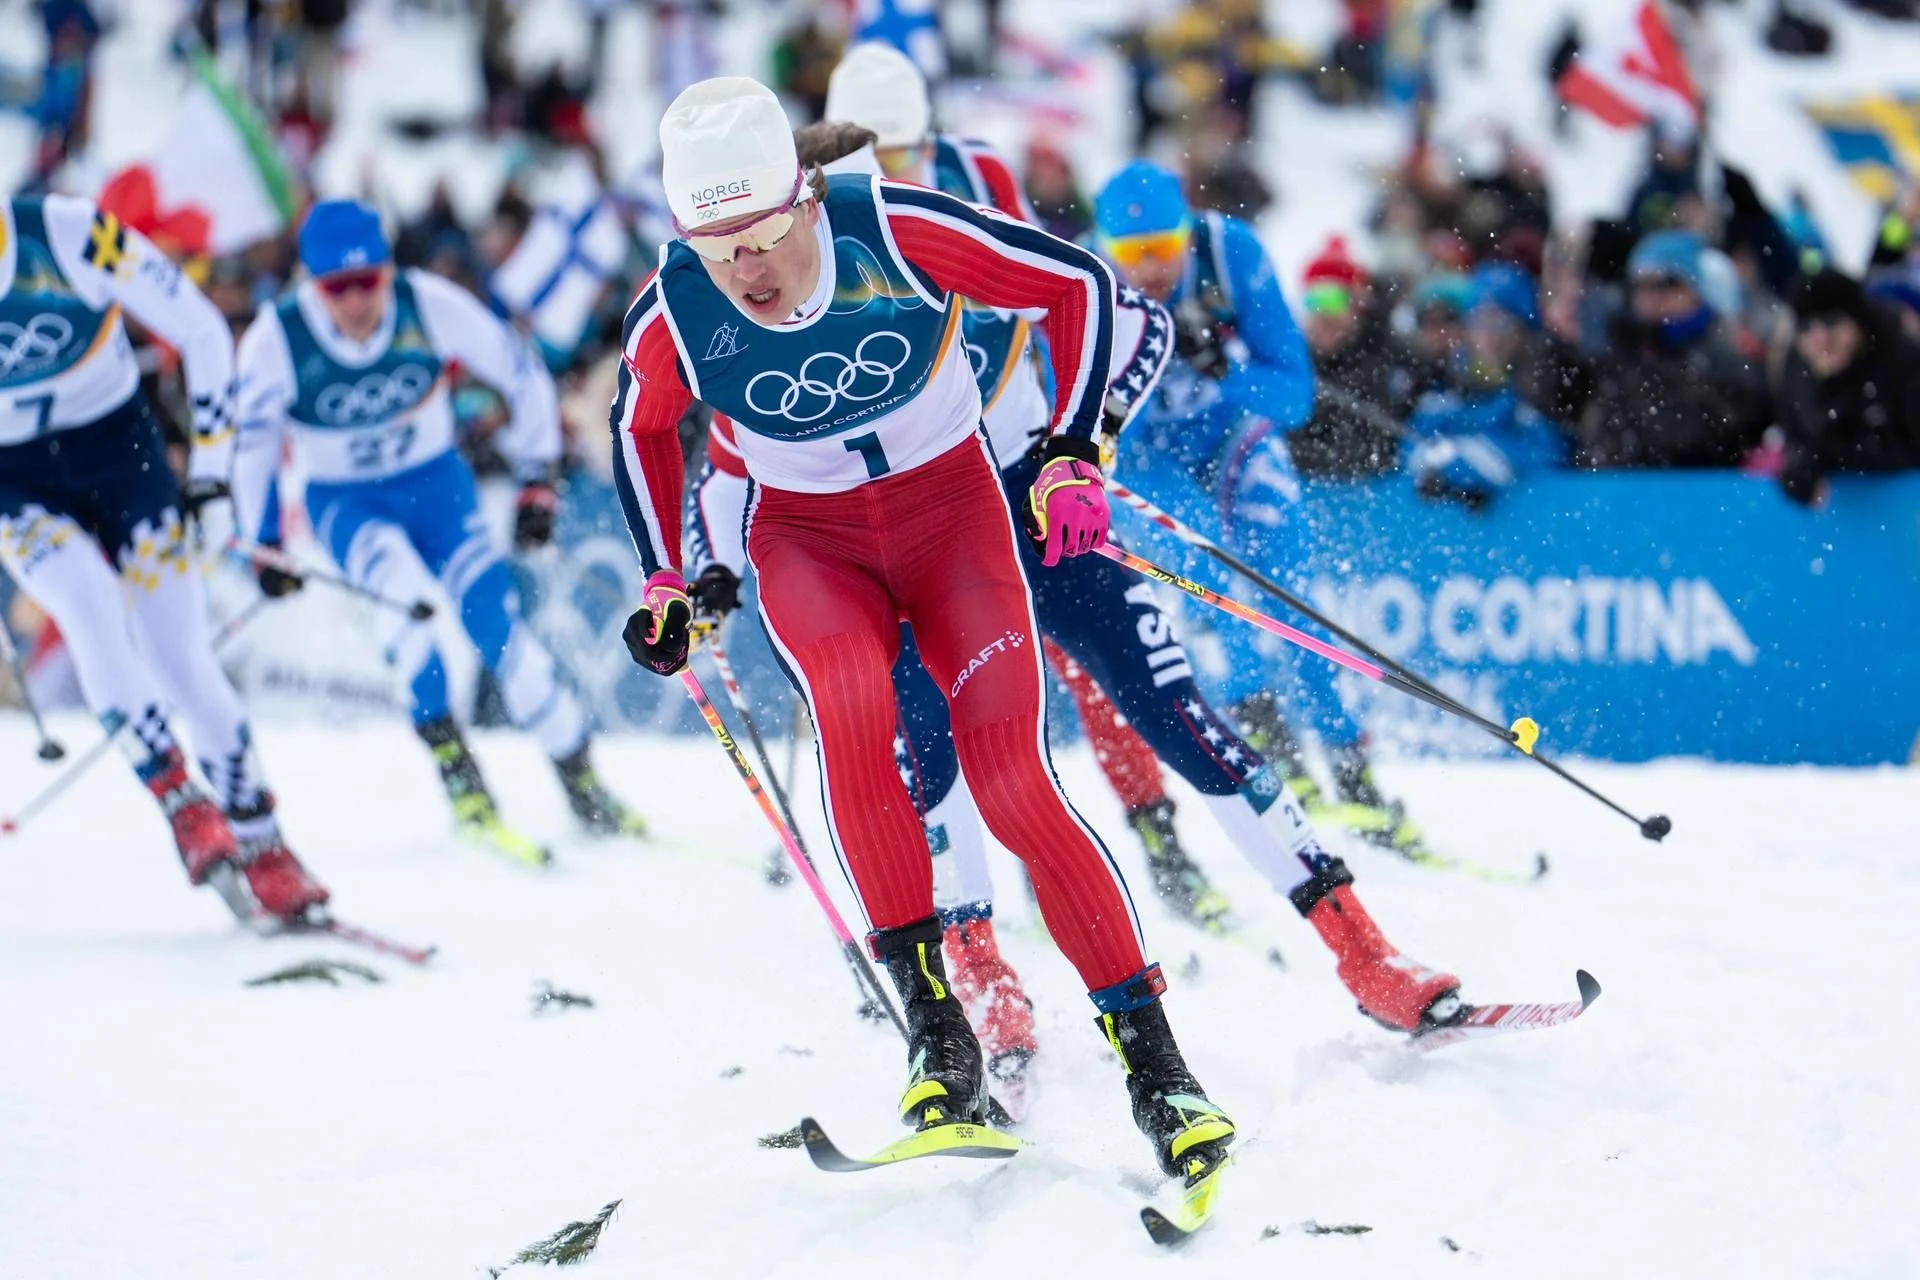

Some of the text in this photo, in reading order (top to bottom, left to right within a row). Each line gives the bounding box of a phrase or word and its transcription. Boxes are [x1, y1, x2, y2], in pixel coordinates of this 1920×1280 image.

[691, 179, 751, 204] NORGE
[834, 393, 907, 425] CORTINA
[843, 431, 891, 479] 1
[1430, 573, 1758, 667] CORTINA
[951, 637, 1007, 699] CRAFT
